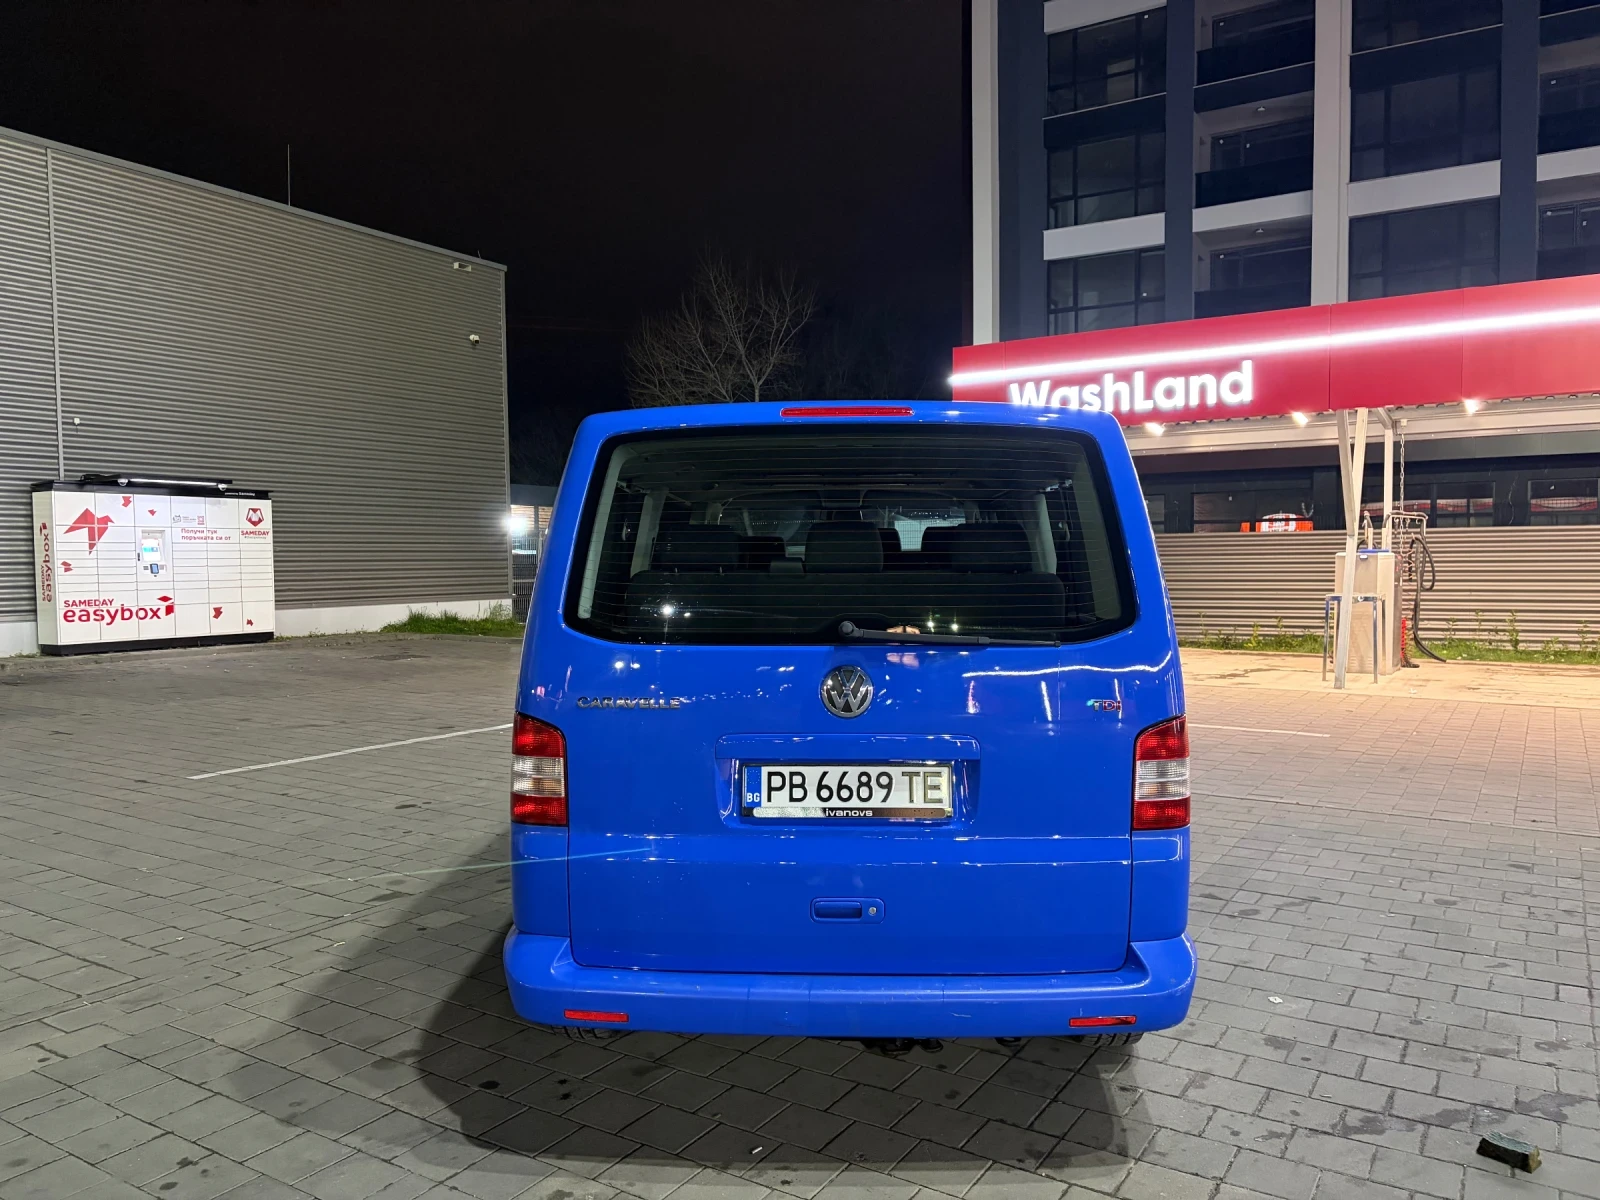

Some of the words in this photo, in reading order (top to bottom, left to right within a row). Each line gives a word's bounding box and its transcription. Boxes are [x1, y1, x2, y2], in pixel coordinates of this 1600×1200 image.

[1009, 359, 1253, 413] WashLand
[43, 533, 52, 602] easybox
[63, 599, 114, 608] SAMEDAY
[63, 604, 162, 626] easybox
[577, 696, 680, 709] CARAVELLE
[766, 771, 808, 803] PB
[816, 771, 893, 803] 6689
[902, 771, 943, 803] TE
[746, 792, 760, 802] BG
[825, 808, 873, 817] ivanovs
